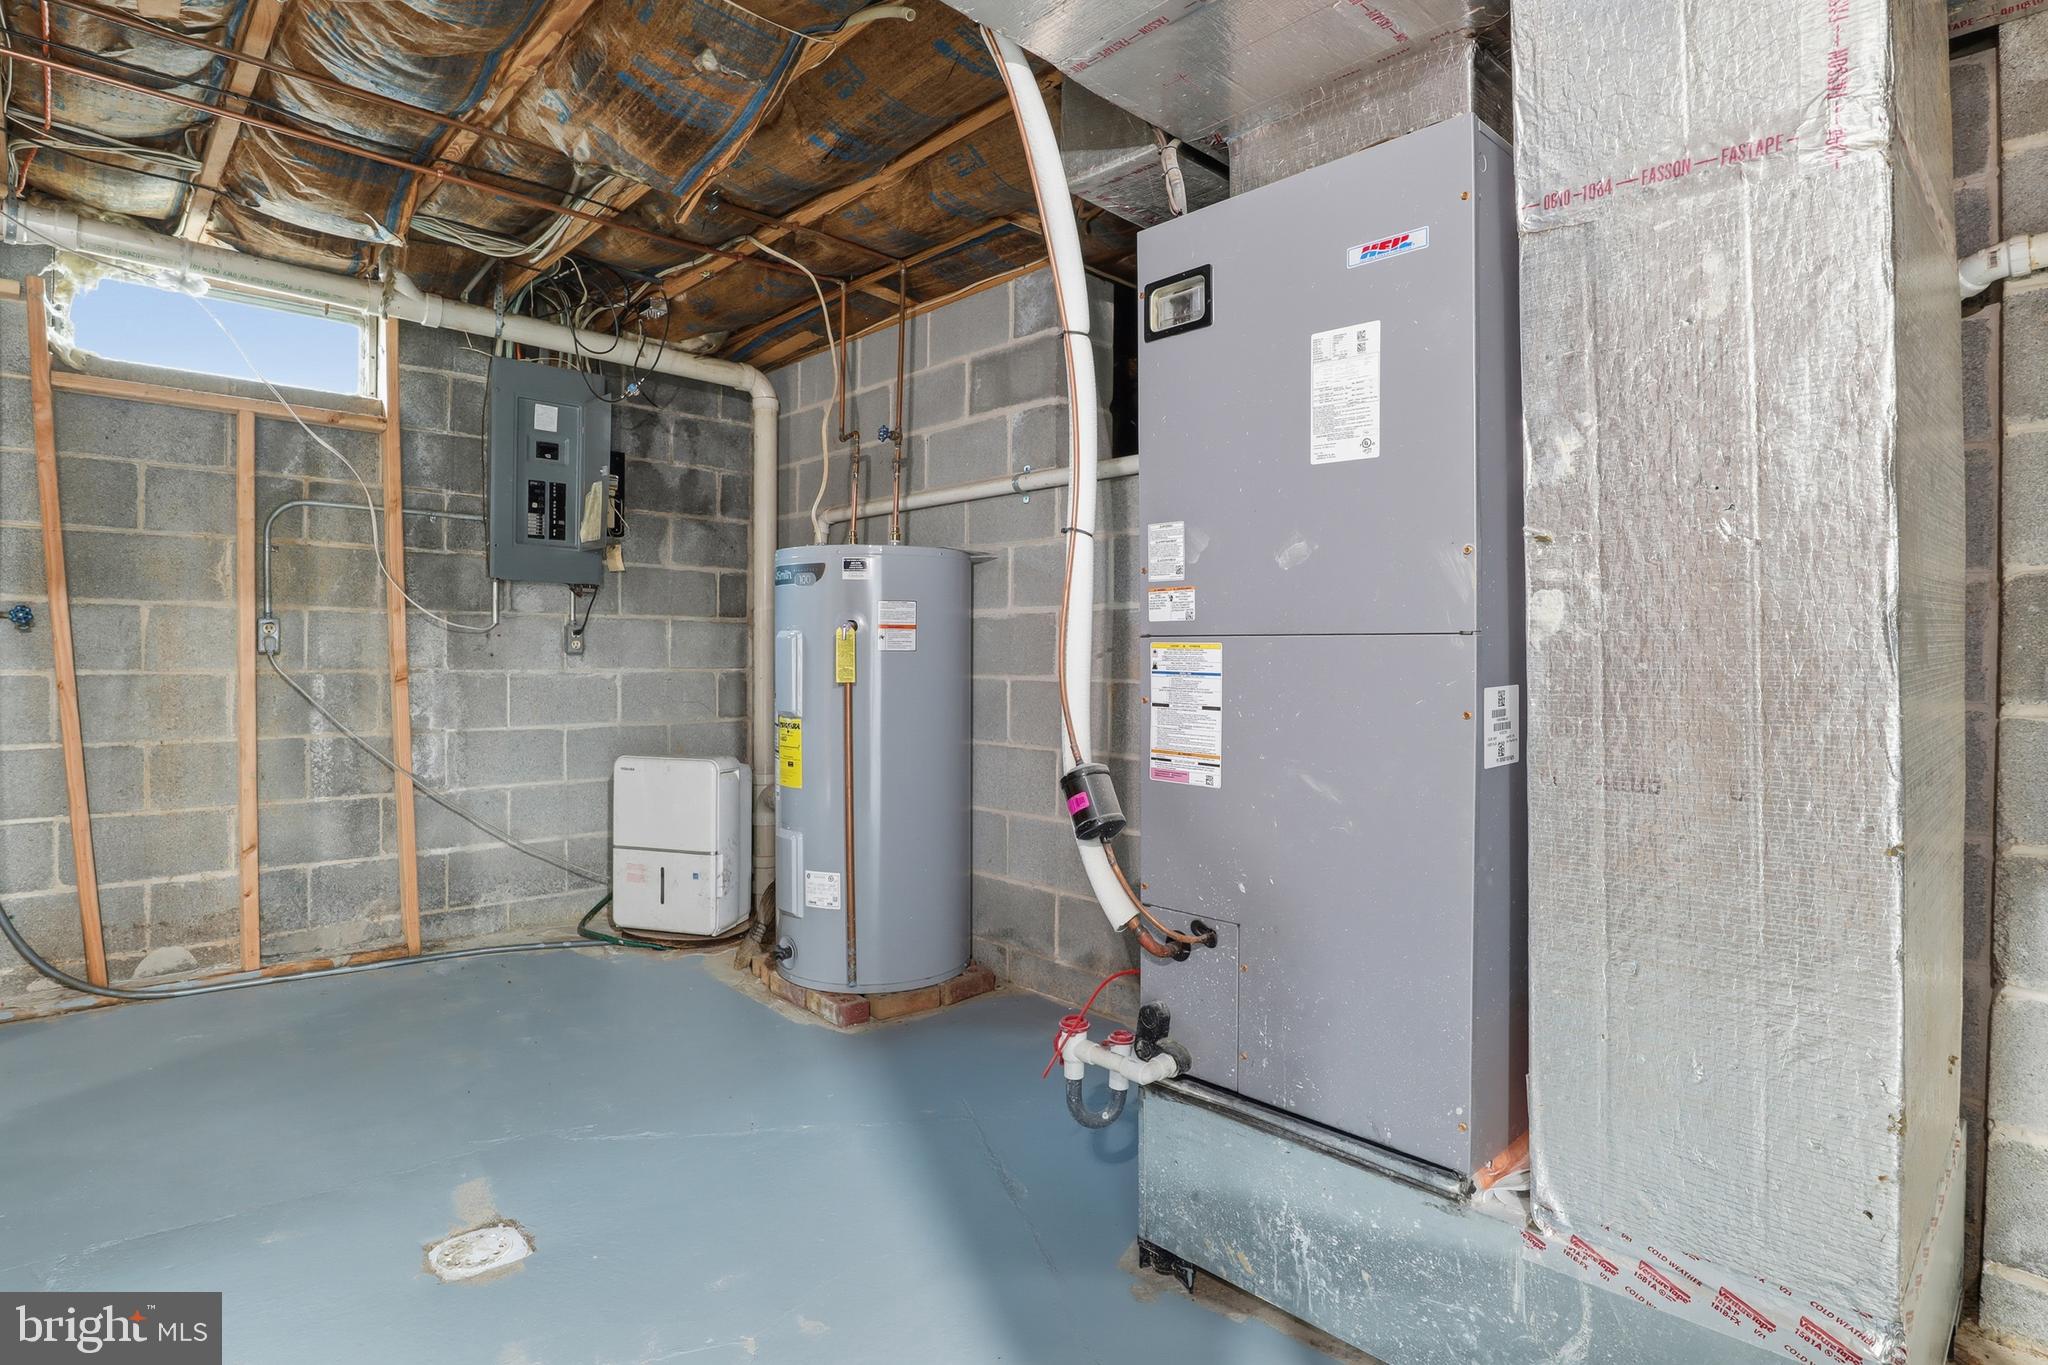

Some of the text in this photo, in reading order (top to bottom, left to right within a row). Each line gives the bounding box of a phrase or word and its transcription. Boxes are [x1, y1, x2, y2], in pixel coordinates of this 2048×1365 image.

[1138, 15, 1170, 35] FASSON
[1641, 157, 1691, 186] FASSON
[1719, 133, 1784, 167] FASTAPE
[1638, 1261, 1692, 1304] VentureTape
[1647, 1246, 1668, 1263] COLD
[1668, 1261, 1702, 1287] WEATHER
[1624, 1286, 1646, 1304] COLD
[1719, 1287, 1776, 1333] VentureTape
[1810, 1300, 1834, 1319] COLD
[1784, 1344, 1808, 1364] COLD
[1799, 1317, 1863, 1365] VentureTape
